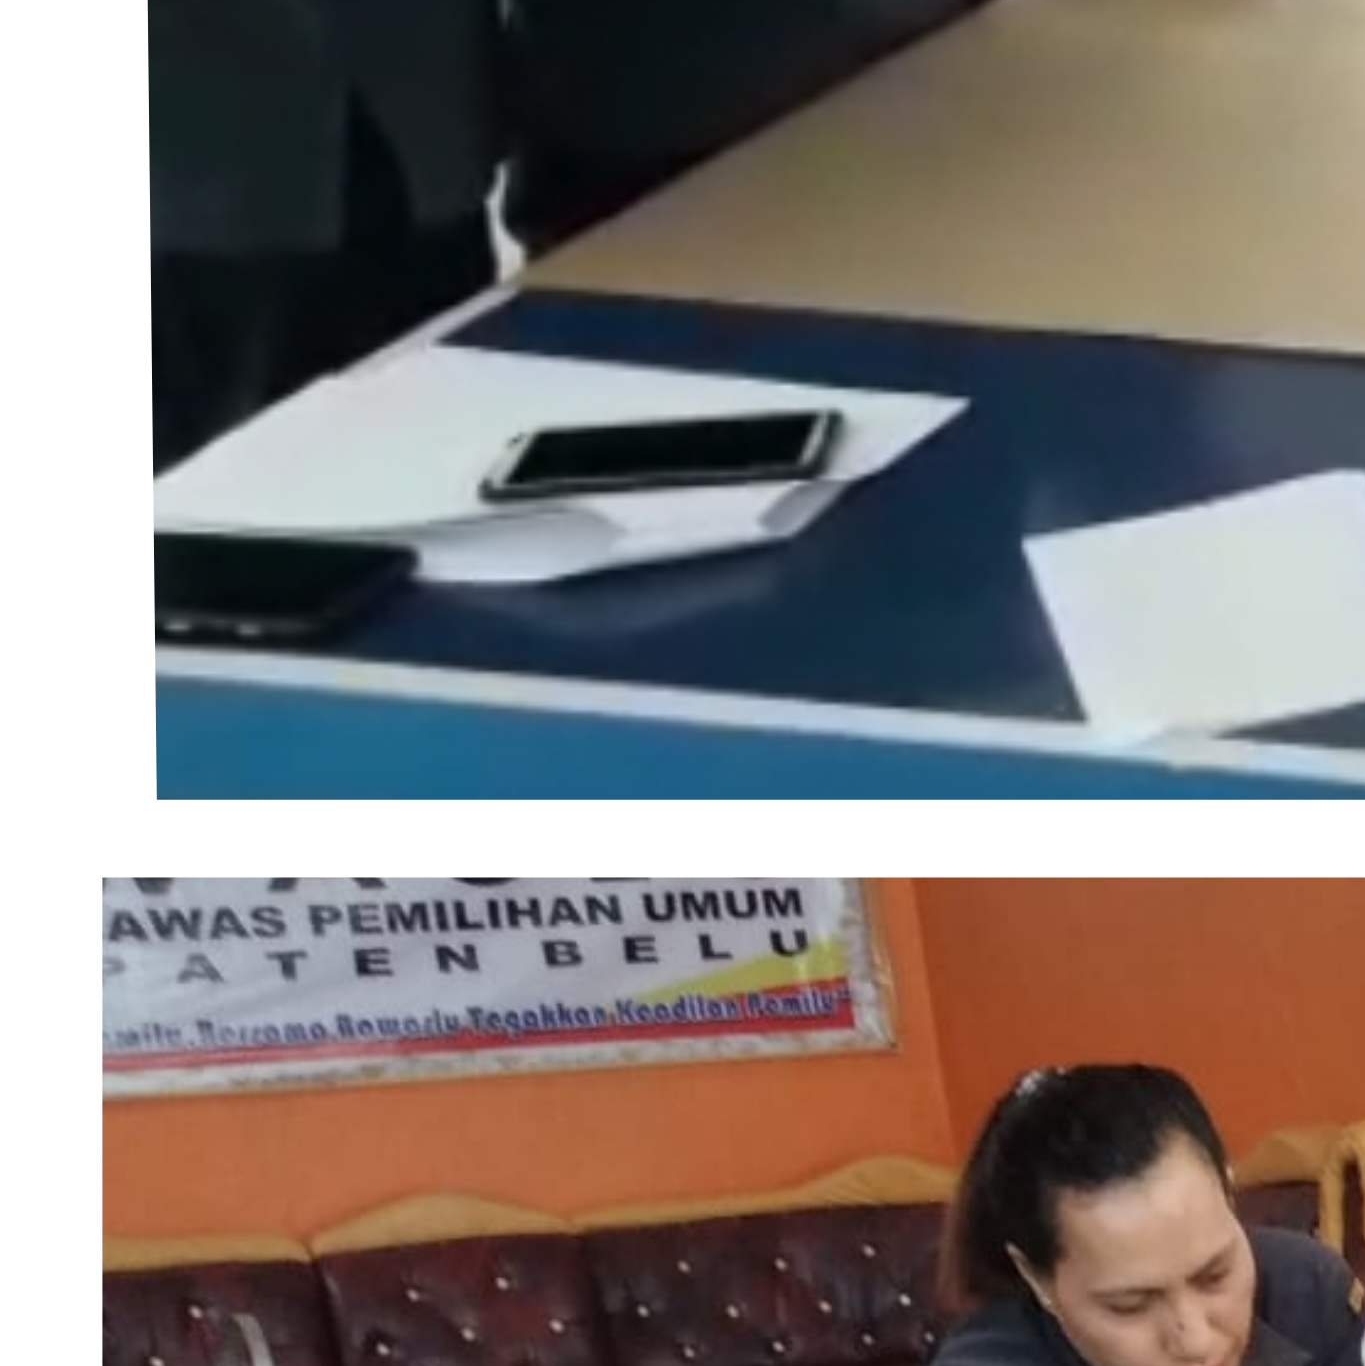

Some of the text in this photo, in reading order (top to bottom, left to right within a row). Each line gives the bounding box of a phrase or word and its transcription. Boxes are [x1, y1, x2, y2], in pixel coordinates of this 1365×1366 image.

[107, 888, 803, 941] AWAS PEMILIHAN UMUM
[541, 929, 809, 968] BELU
[466, 1000, 608, 1036] Tegakkan
[614, 992, 739, 1024] Keadilan
